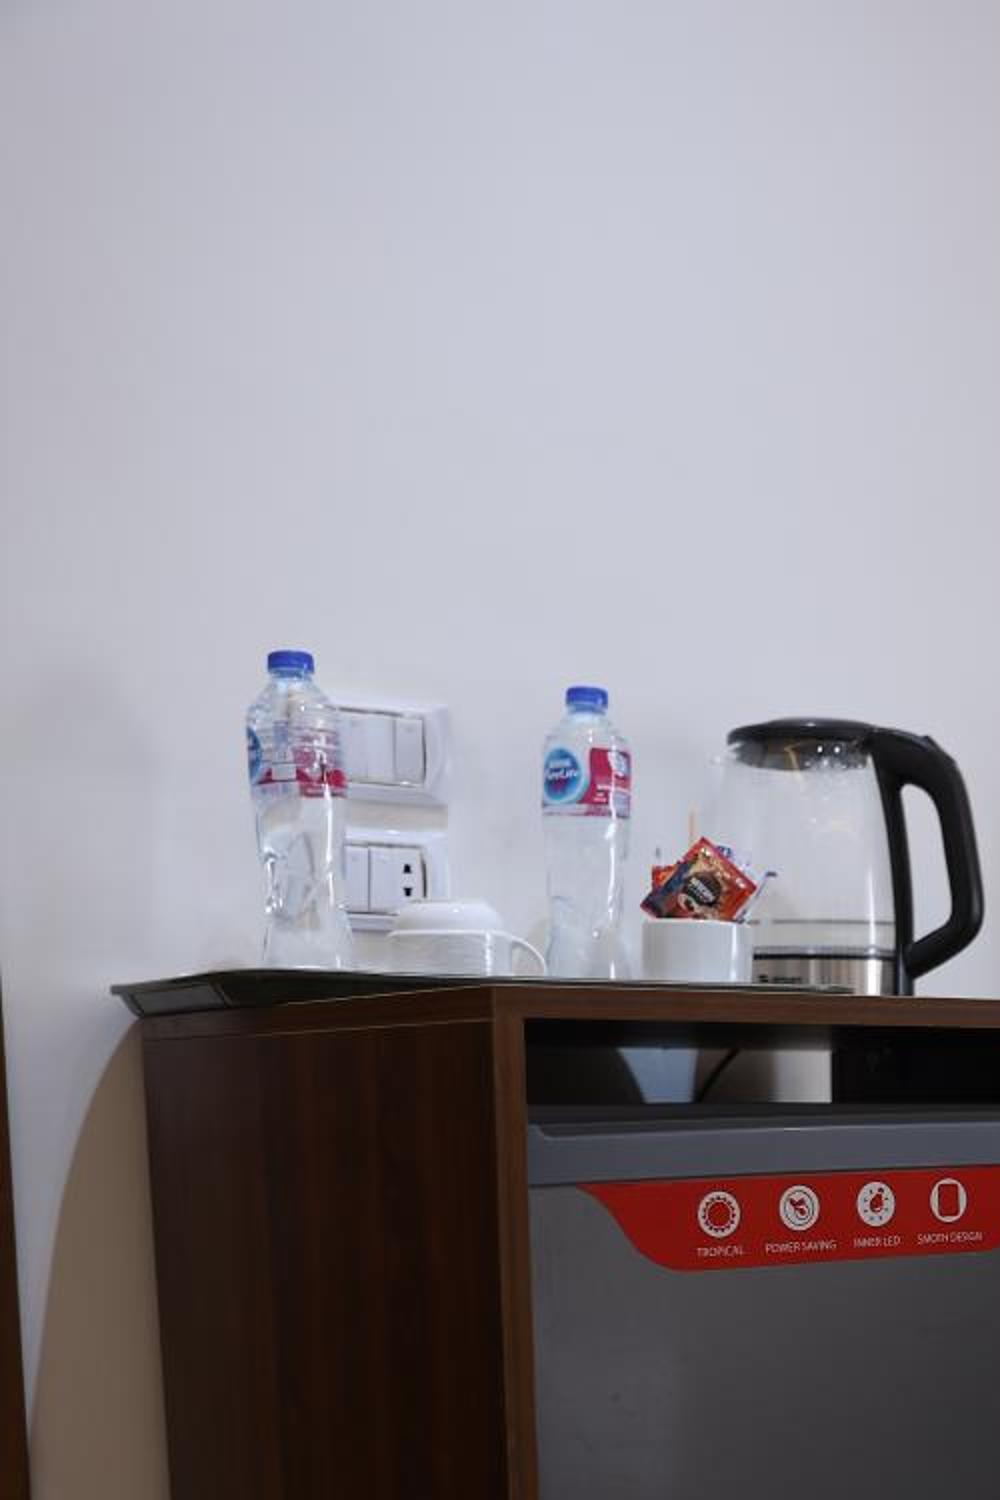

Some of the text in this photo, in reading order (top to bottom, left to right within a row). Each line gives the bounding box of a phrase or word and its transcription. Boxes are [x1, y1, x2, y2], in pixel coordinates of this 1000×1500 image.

[853, 1235, 901, 1248] INNER LED
[950, 1231, 983, 1242] DESIGN
[697, 1246, 743, 1257] TROPICAL
[765, 1239, 837, 1254] POWER SAVING
